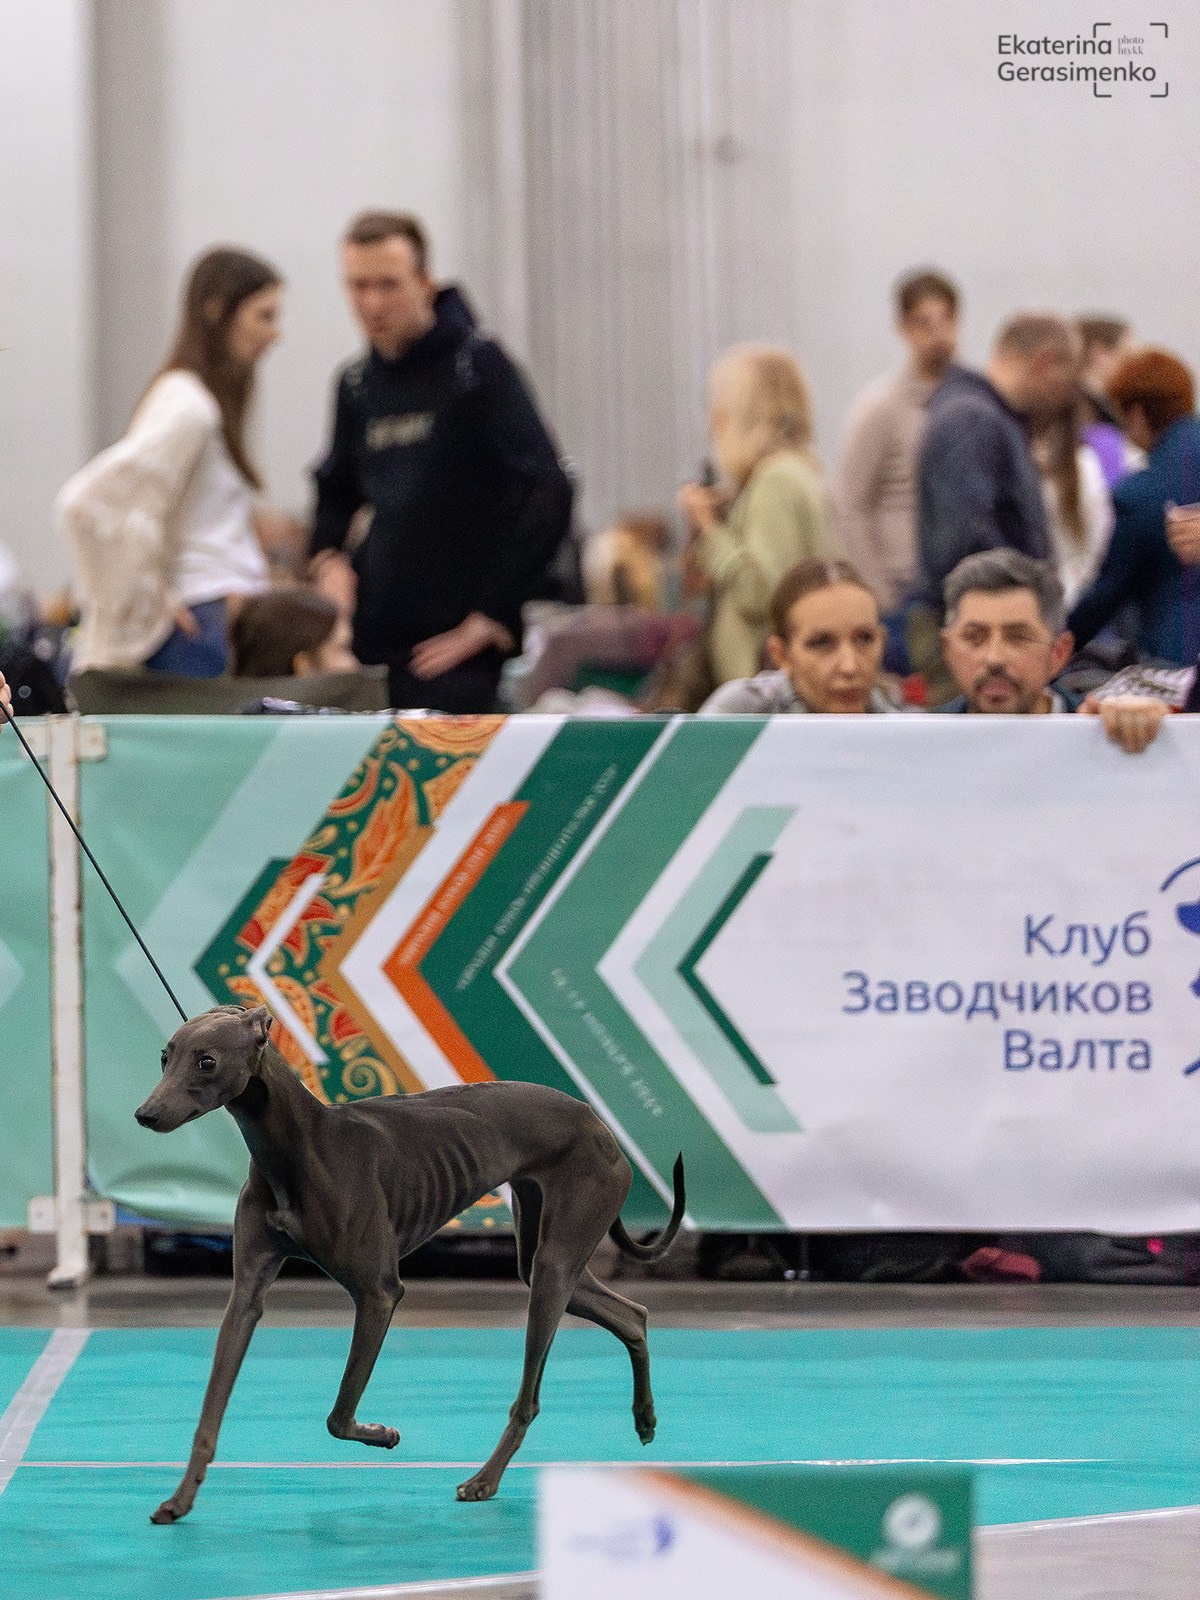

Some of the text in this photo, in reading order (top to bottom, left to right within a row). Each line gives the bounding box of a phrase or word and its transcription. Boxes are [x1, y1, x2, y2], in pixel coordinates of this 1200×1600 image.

[1024, 909, 1151, 967] Клуб
[841, 969, 1153, 1022] Заводчиков
[1002, 1028, 1153, 1073] Валта
